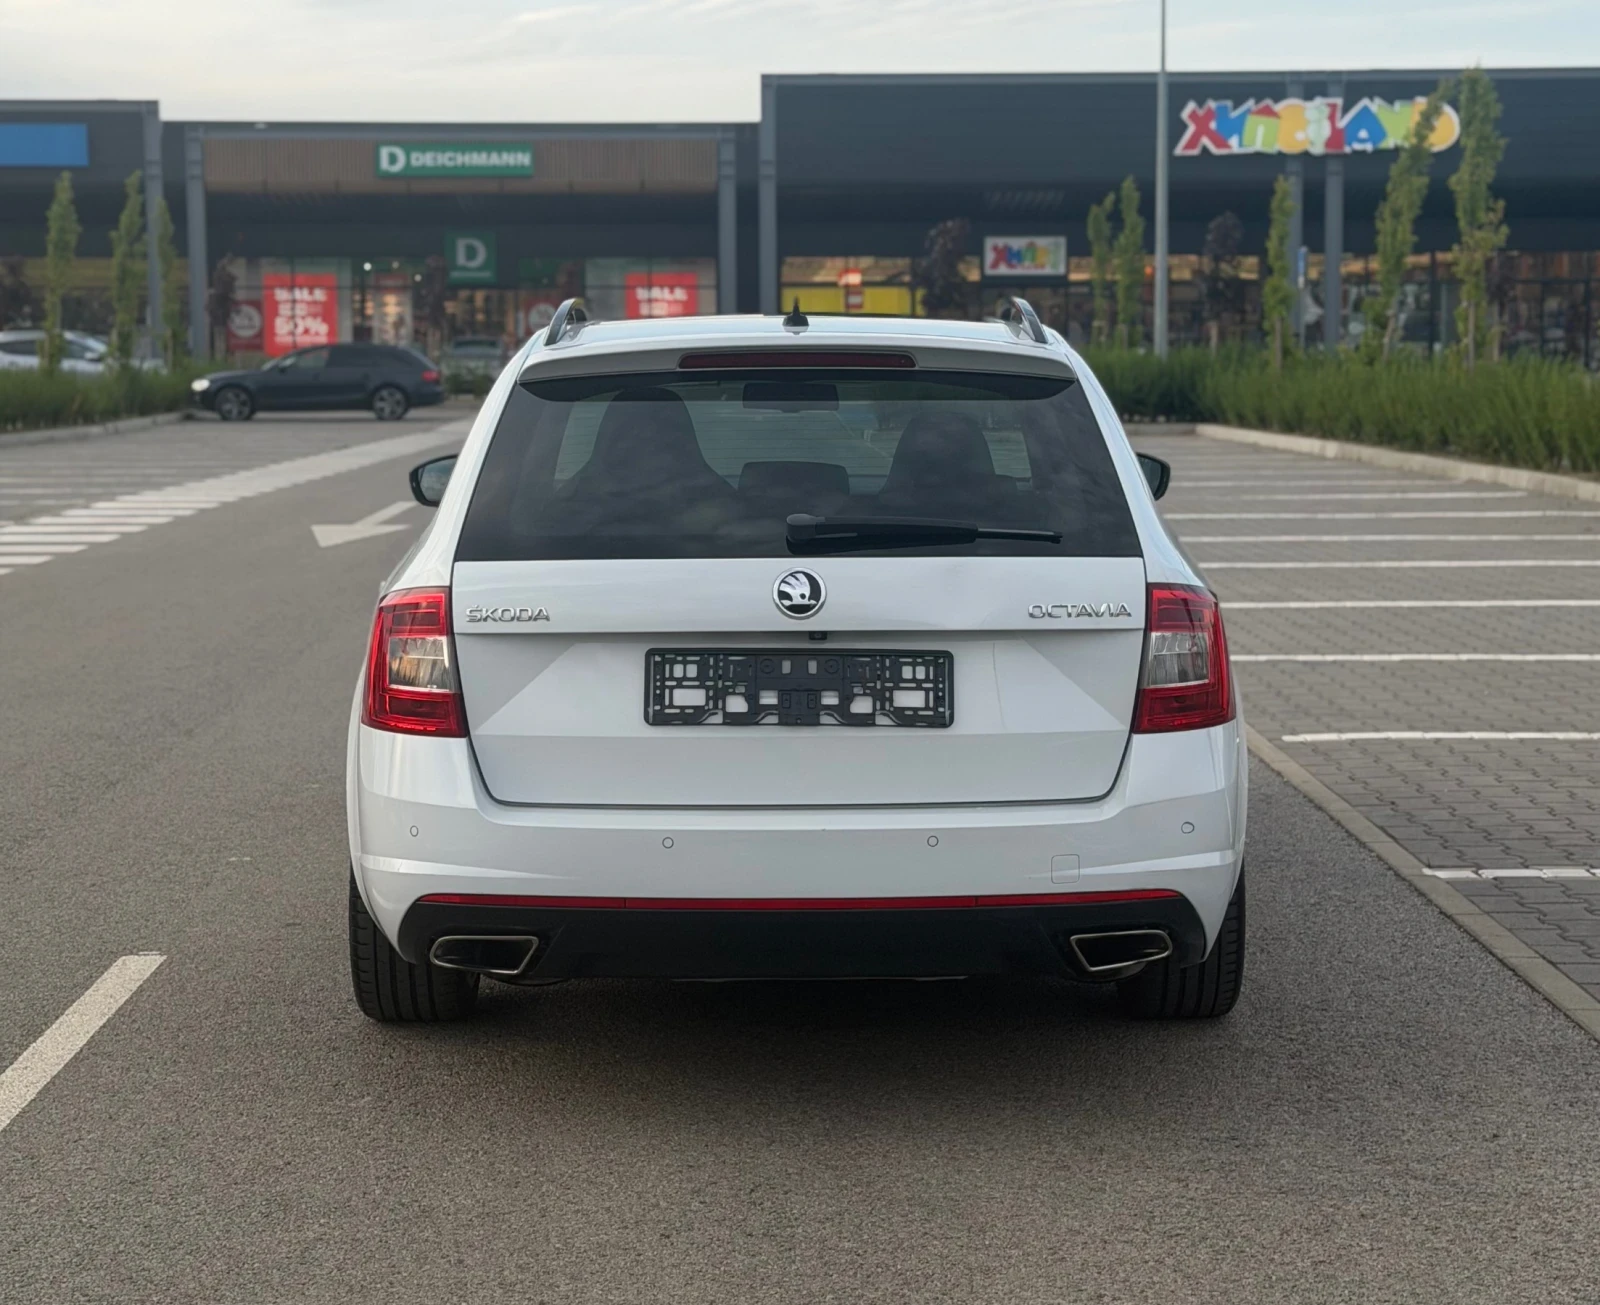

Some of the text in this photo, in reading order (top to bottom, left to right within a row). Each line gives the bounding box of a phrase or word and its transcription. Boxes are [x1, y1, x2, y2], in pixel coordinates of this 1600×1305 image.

[410, 151, 531, 167] DEICHMANN
[456, 238, 488, 268] D
[466, 604, 550, 622] ŠKODA
[1028, 602, 1132, 618] OCTAVIA
